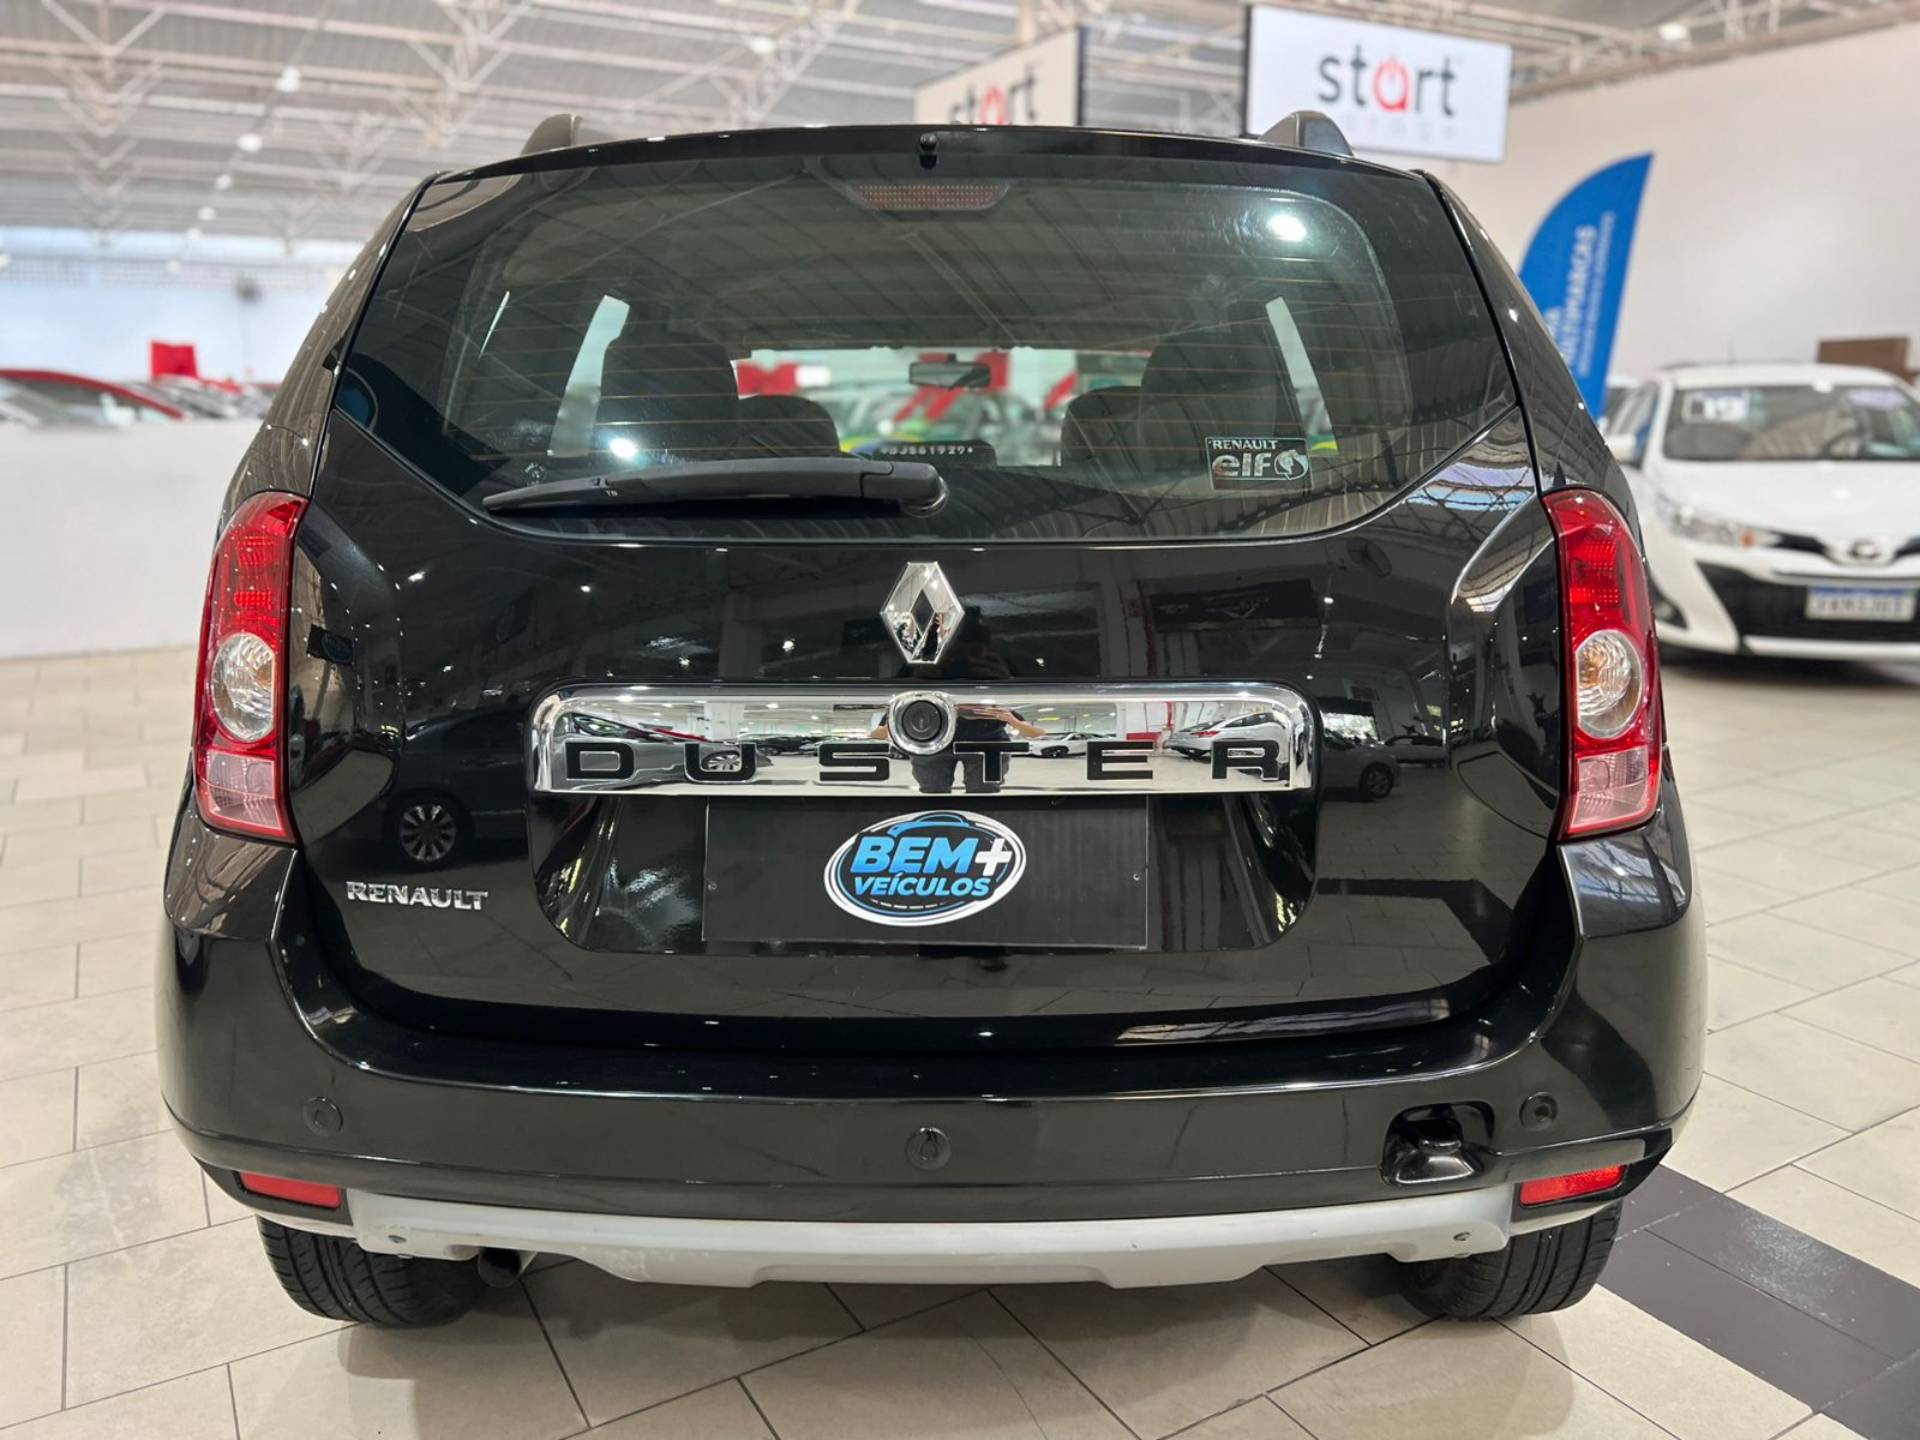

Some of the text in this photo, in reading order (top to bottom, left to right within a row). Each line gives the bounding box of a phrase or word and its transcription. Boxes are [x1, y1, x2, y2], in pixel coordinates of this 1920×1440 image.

[1318, 43, 1456, 116] start
[1211, 438, 1279, 450] RENAULT
[1211, 452, 1273, 477] elf
[564, 740, 1283, 784] DUSTER
[346, 880, 489, 910] RENAULT
[853, 872, 992, 896] VEÍCULOS
